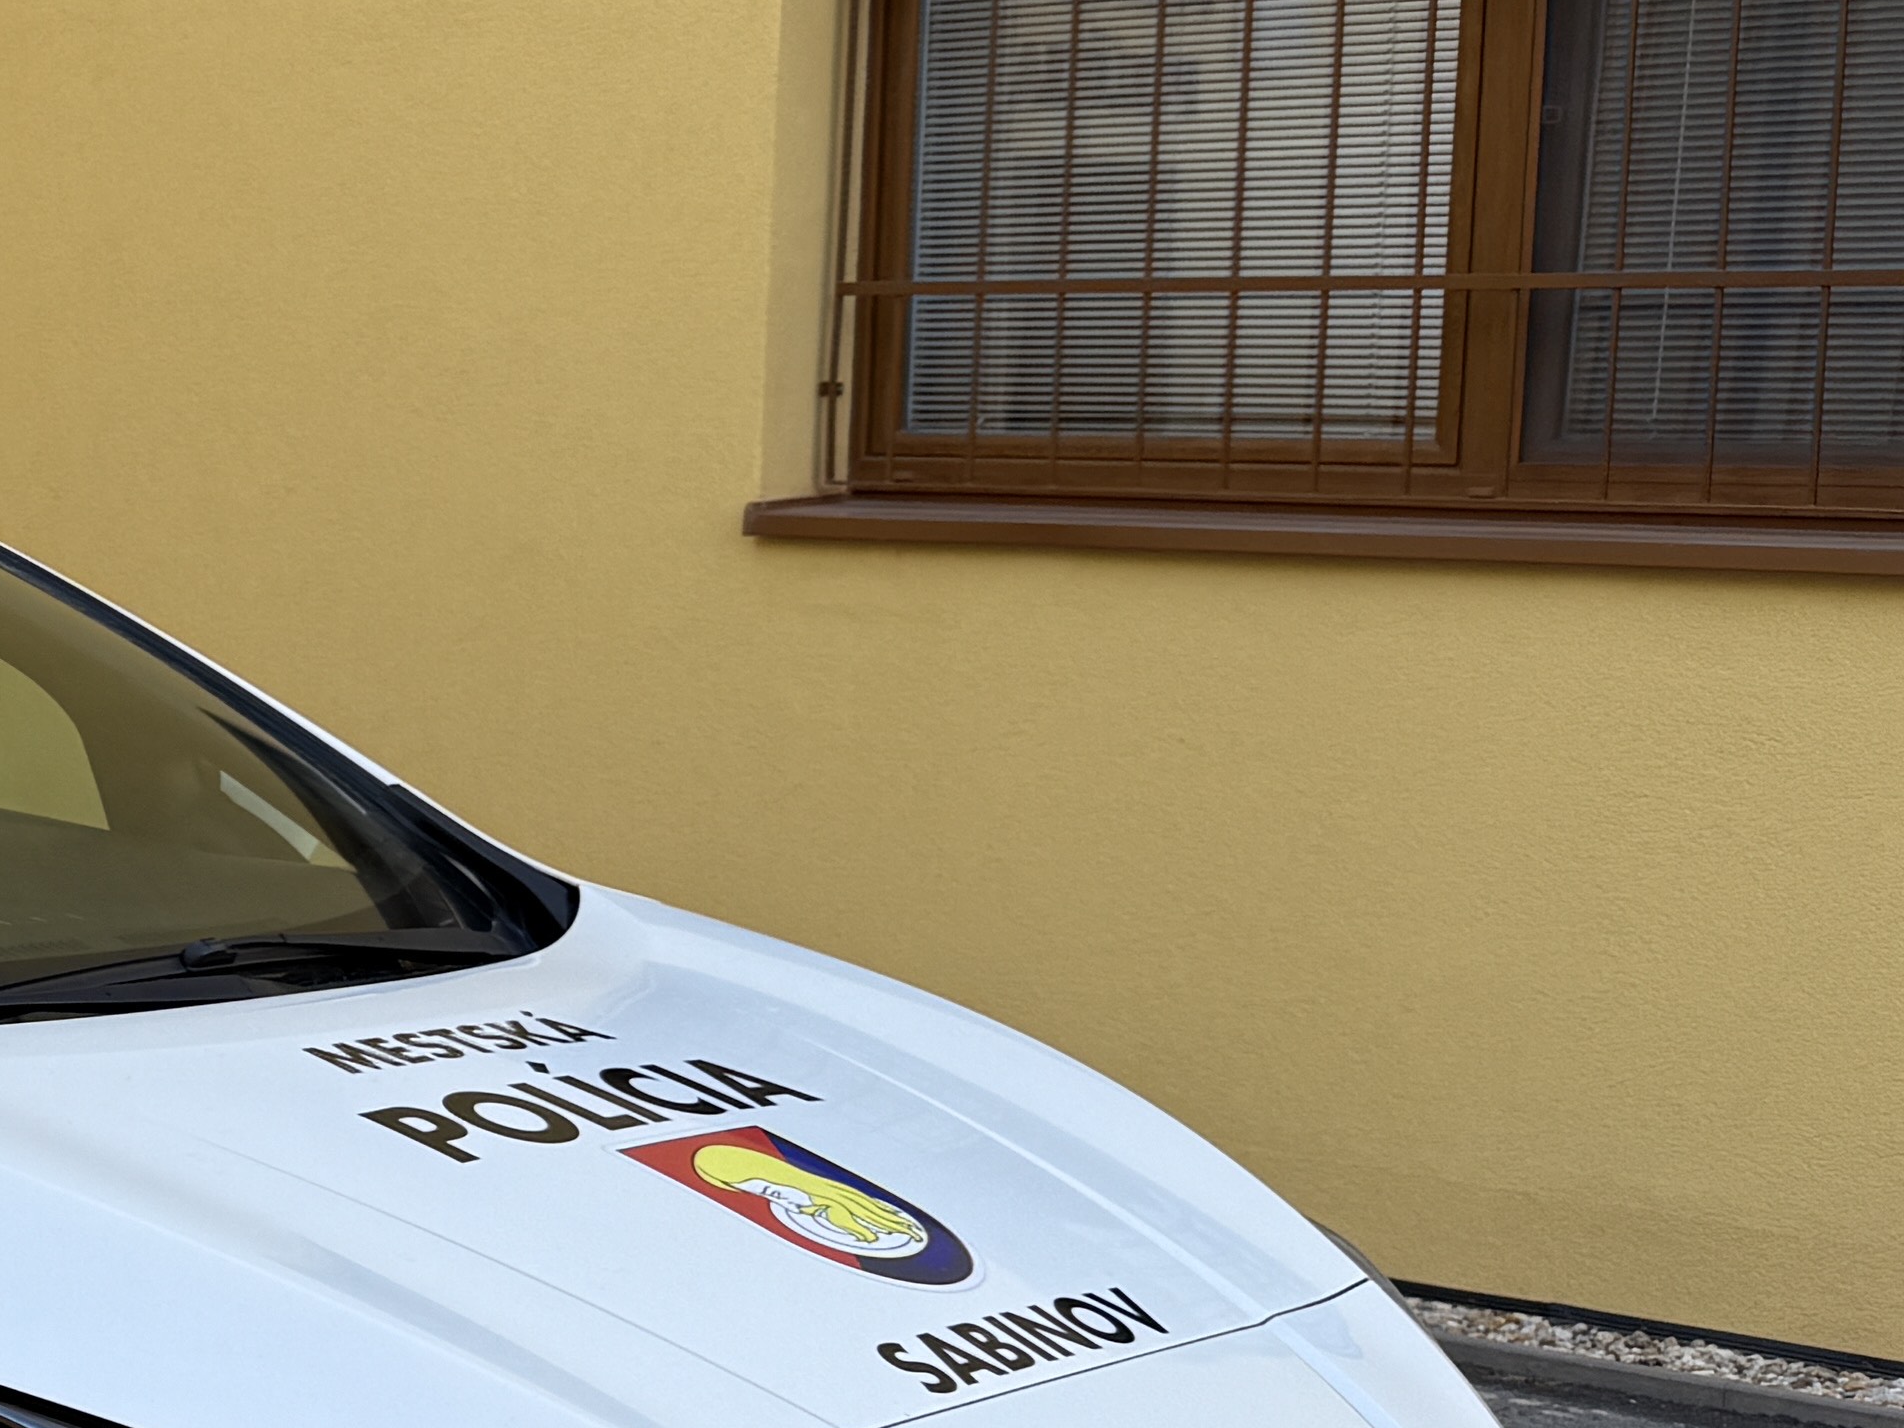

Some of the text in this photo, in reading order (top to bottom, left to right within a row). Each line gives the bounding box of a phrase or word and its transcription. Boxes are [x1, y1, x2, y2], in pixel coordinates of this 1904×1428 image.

[302, 1010, 616, 1074] MESTSKÁ
[358, 1058, 825, 1164] POLÍCIA
[876, 1285, 1172, 1394] SABINOV
